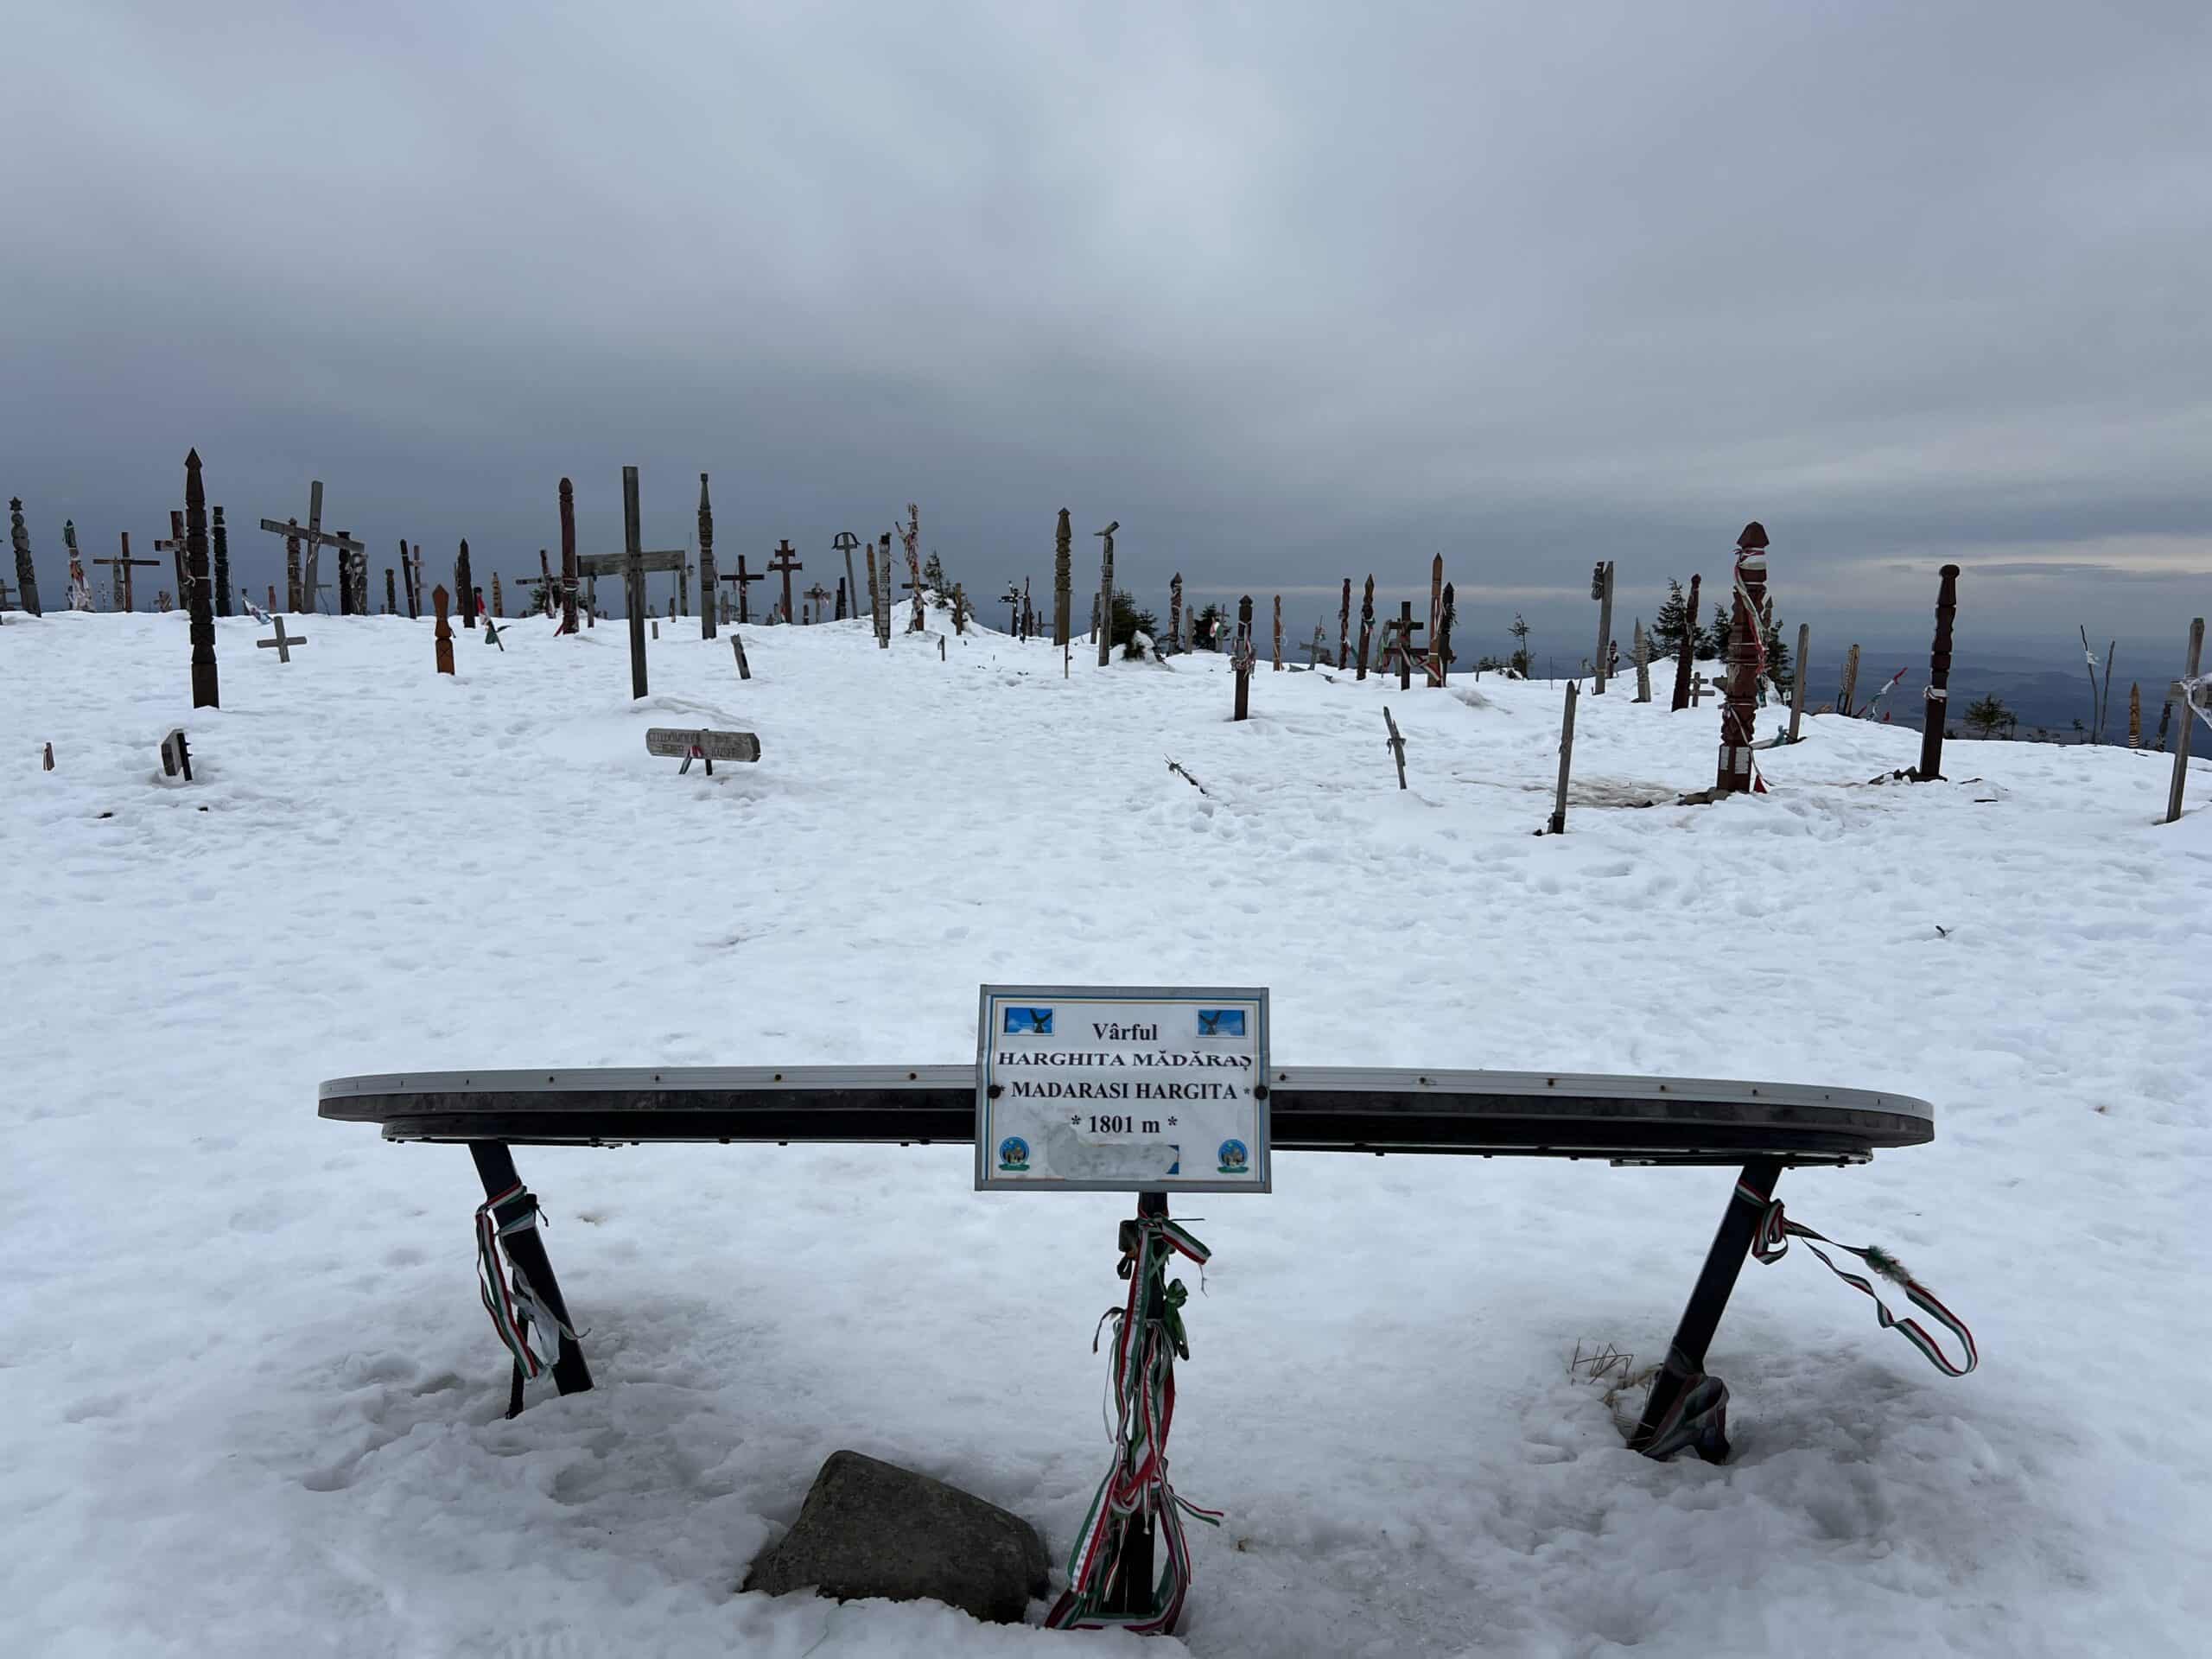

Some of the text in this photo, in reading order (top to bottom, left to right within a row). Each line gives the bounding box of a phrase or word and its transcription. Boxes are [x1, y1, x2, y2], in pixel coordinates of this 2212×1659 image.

[1091, 1021, 1158, 1042] Vârful
[998, 1052, 1126, 1067] HARGHITA
[1011, 1081, 1238, 1100] MADARASI HARGITA
[1088, 1115, 1161, 1134] 1801 m
